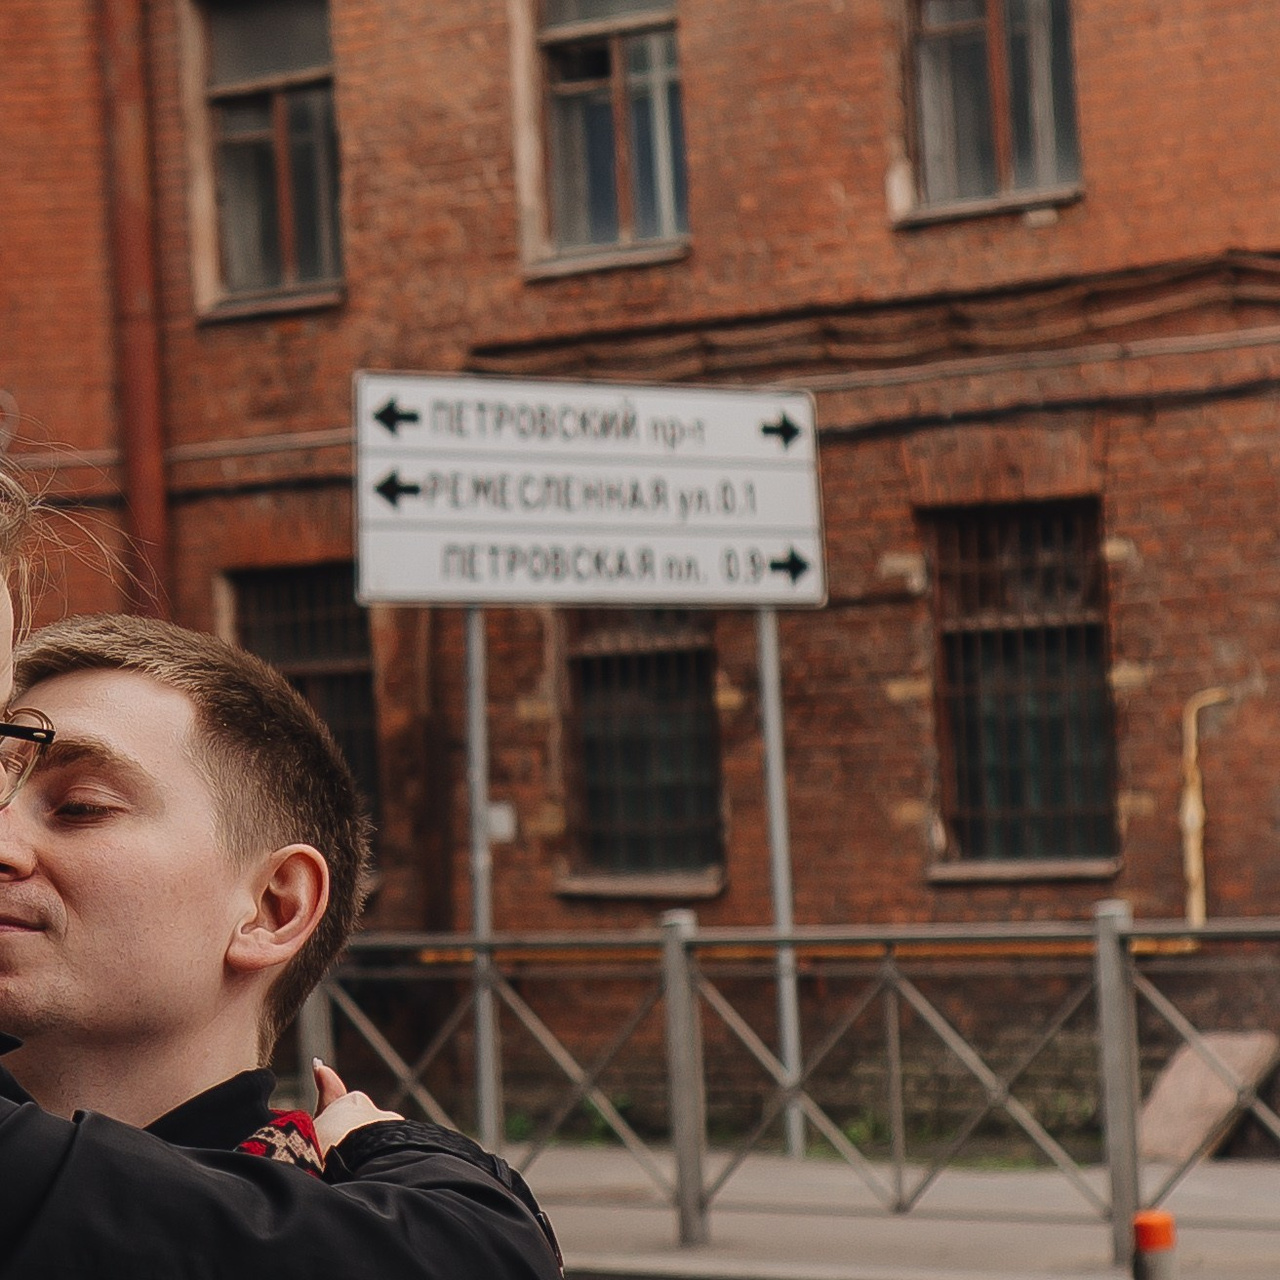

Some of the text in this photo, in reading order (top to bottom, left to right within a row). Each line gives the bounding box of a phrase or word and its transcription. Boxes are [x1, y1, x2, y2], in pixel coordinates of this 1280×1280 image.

[430, 397, 638, 439] ПЕТРОВСКИЙ
[425, 472, 668, 512] РЕМЕСЛЕННАЯ
[442, 542, 656, 584] ПЕТРОВСКАЯ
